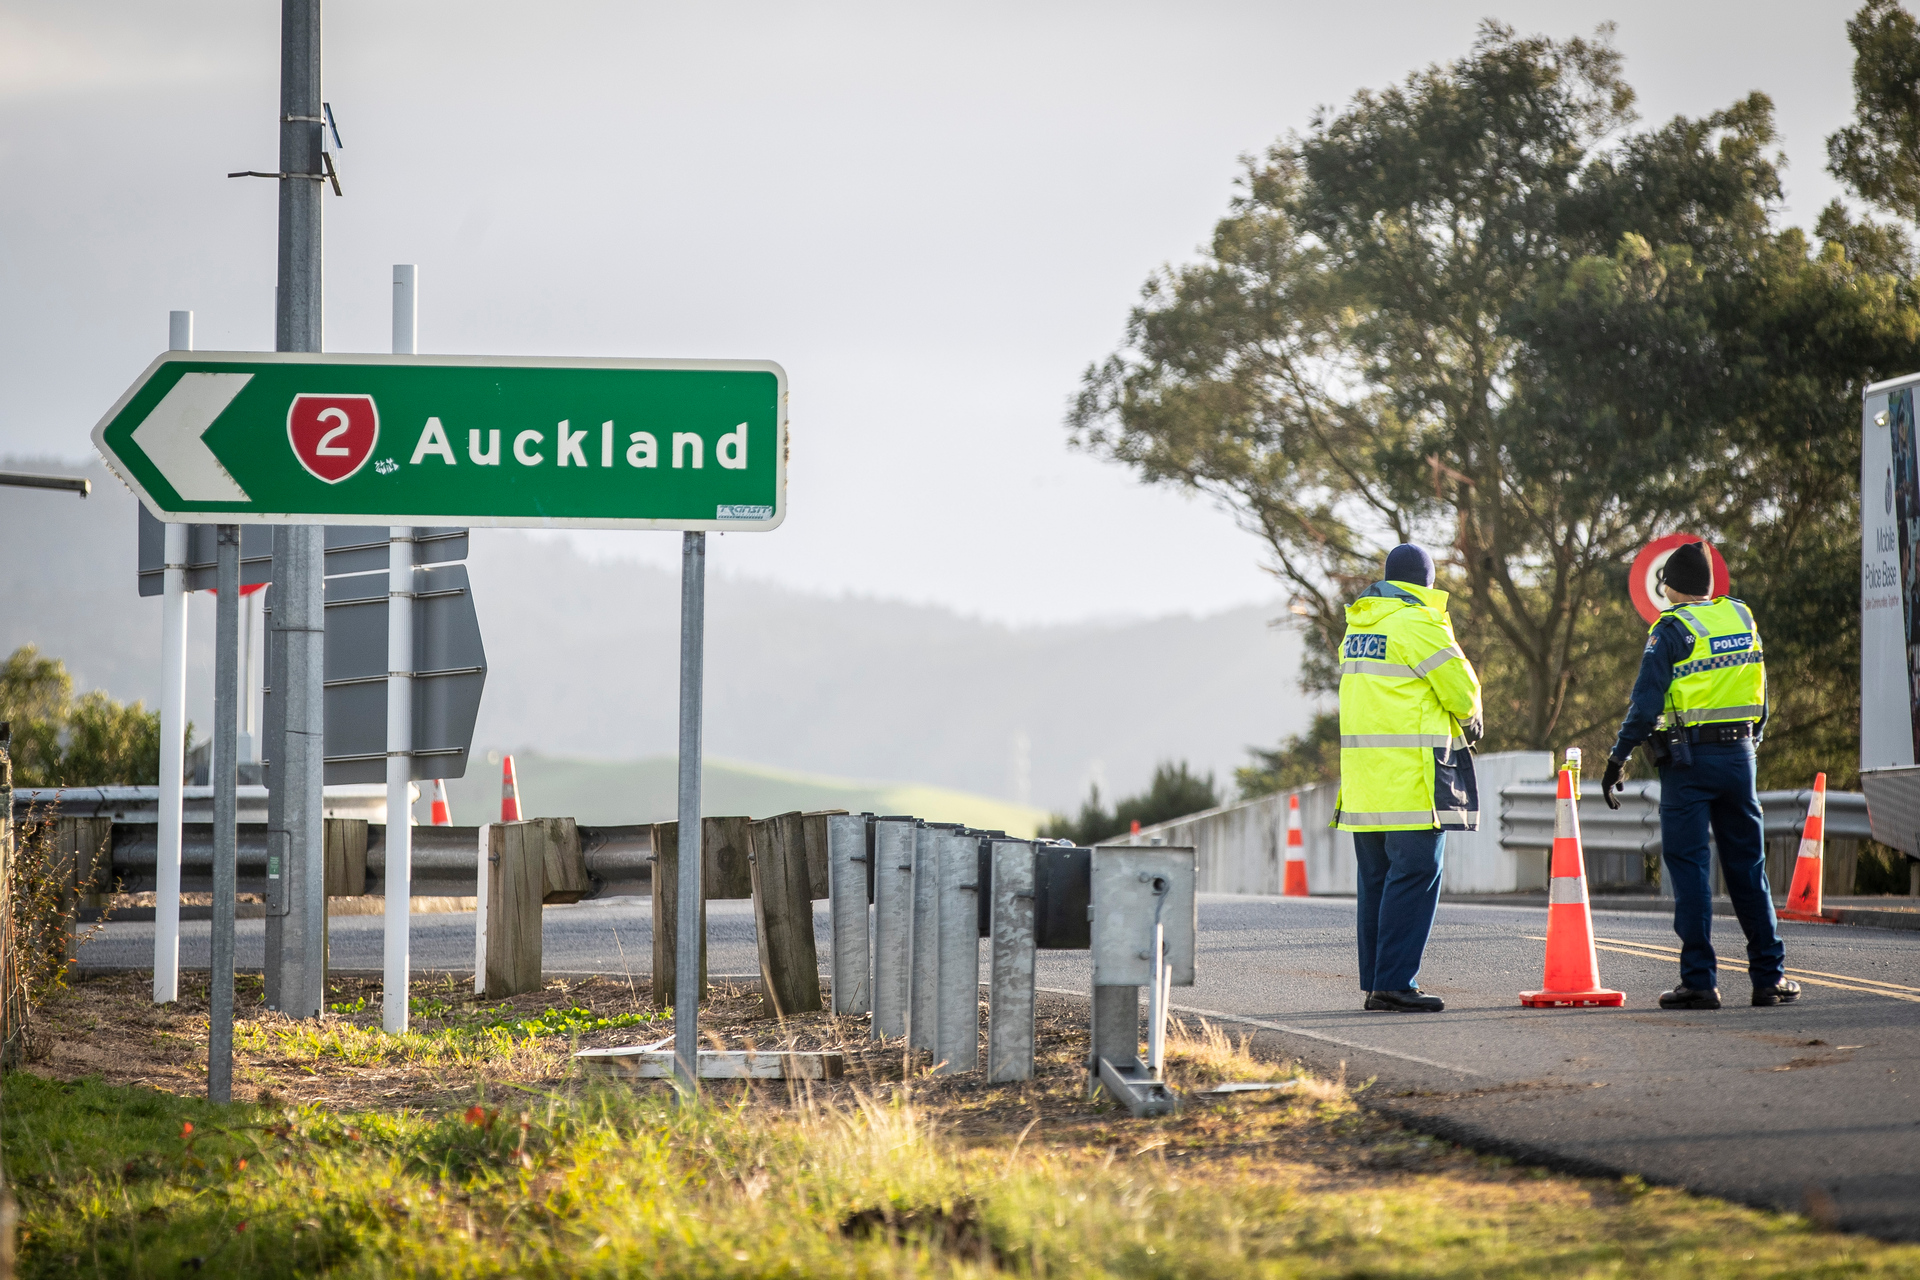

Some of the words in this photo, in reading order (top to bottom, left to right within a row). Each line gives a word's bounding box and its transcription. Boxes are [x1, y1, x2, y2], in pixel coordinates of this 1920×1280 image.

[316, 407, 349, 456] 2
[409, 416, 748, 470] Auckland
[1876, 525, 1896, 554] Mobile
[1865, 562, 1881, 590] Police
[1882, 560, 1897, 588] Base
[1343, 636, 1387, 658] POLICE
[1713, 636, 1753, 651] POLICE
